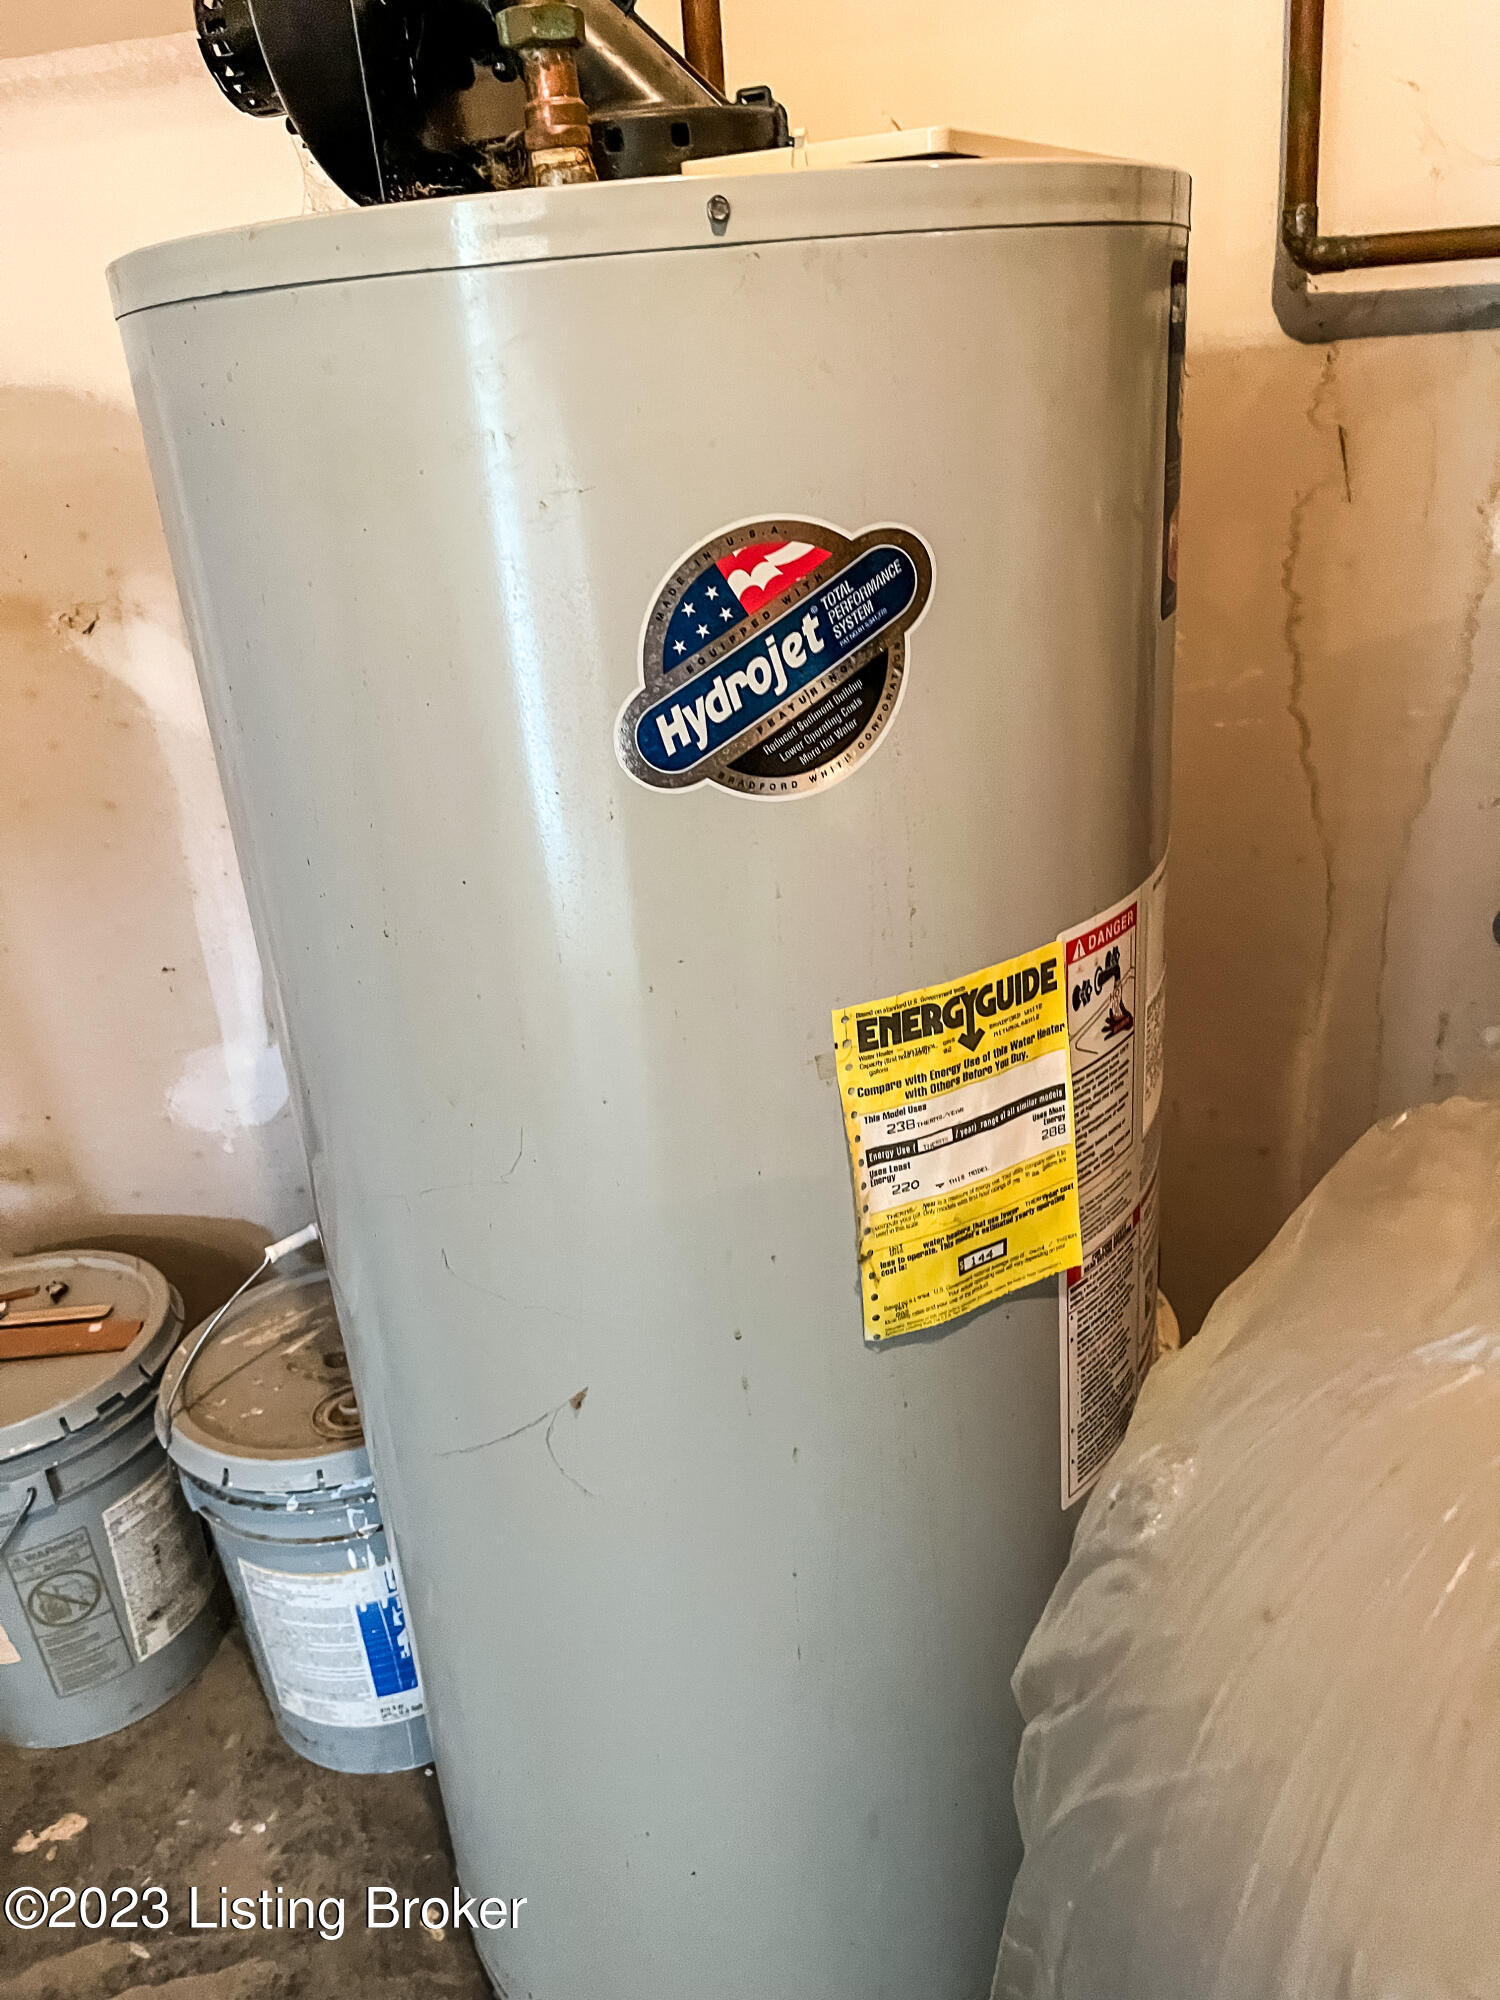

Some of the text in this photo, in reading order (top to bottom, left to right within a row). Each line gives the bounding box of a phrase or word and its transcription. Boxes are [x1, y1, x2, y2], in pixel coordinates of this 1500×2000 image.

[655, 577, 685, 621] MADE
[695, 551, 711, 567] IN
[820, 580, 855, 610] TOTAL
[828, 558, 902, 625] PERFORMANCE
[686, 573, 823, 674] EQUIPPED WITH
[832, 599, 875, 639] SYSTEM
[756, 664, 849, 736] FEATURING
[778, 697, 864, 763] Lower Operating Costs
[799, 718, 859, 766] More Hot Water
[717, 771, 798, 791] BRADFORD
[1088, 910, 1134, 951] DANGER
[856, 957, 1058, 1054] ENERGYGUIDE
[857, 1079, 902, 1098] Compare
[905, 1073, 927, 1086] with
[930, 1063, 961, 1079] Energy
[963, 1057, 980, 1069] Use
[982, 1051, 991, 1062] of
[993, 1045, 1008, 1059] this
[1010, 1034, 1035, 1052] Water
[1037, 1022, 1065, 1040] Heater
[905, 1051, 1029, 1099] with Others Before You Buy.
[864, 1103, 927, 1125] This Model Uses
[868, 1149, 894, 1161] Energy
[896, 1145, 911, 1156] Use
[980, 1117, 999, 1129] range
[1016, 1098, 1038, 1113] similar
[1039, 1088, 1063, 1103] models
[1032, 1110, 1047, 1122] Uses
[891, 1179, 920, 1196] 220
[971, 1250, 994, 1267] 144
